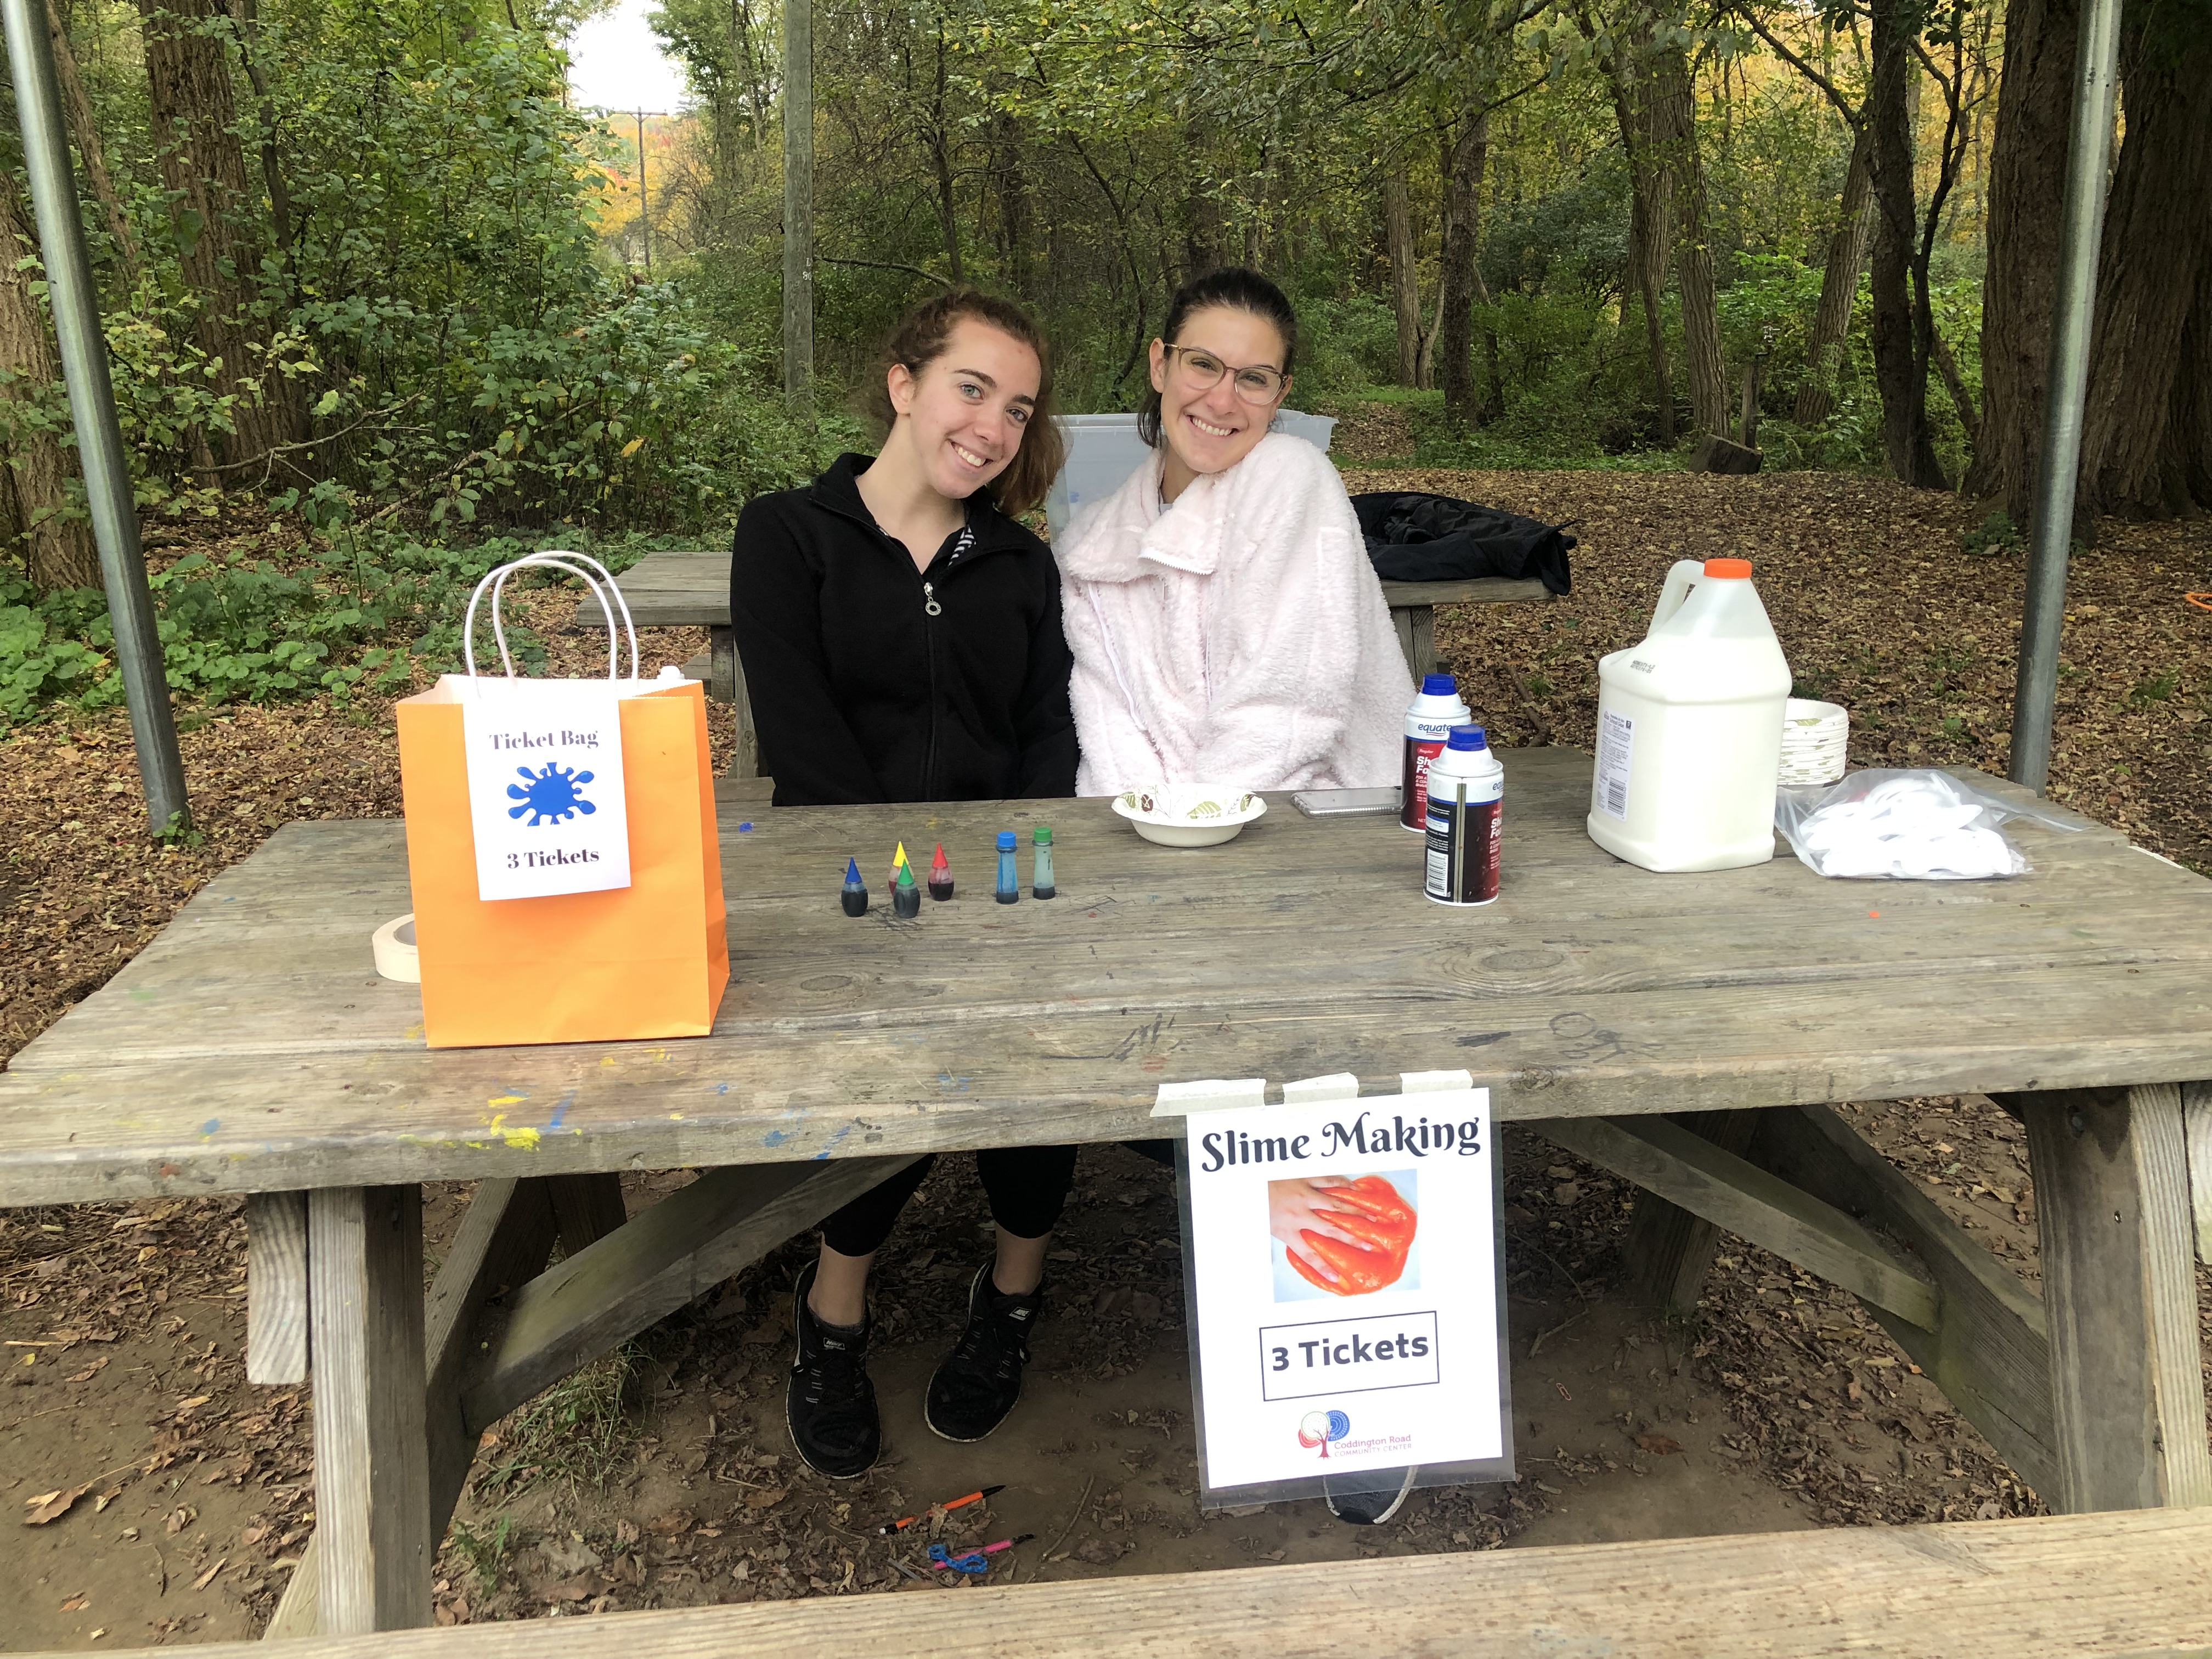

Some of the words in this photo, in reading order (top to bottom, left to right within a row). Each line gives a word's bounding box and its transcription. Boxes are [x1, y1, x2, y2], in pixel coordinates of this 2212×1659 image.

[489, 731, 555, 749] Ticket
[561, 730, 599, 749] Bag
[507, 853, 520, 869] 3
[523, 849, 600, 867] Tickets
[1201, 1130, 1312, 1172] Slime
[1321, 1111, 1482, 1158] Making
[1272, 1347, 1290, 1372] 3
[1298, 1333, 1429, 1368] Tickets
[1334, 1437, 1387, 1449] Coddington
[1389, 1434, 1412, 1443] Road
[1334, 1446, 1381, 1457] COMMUNITY
[1383, 1443, 1412, 1452] CENTER
